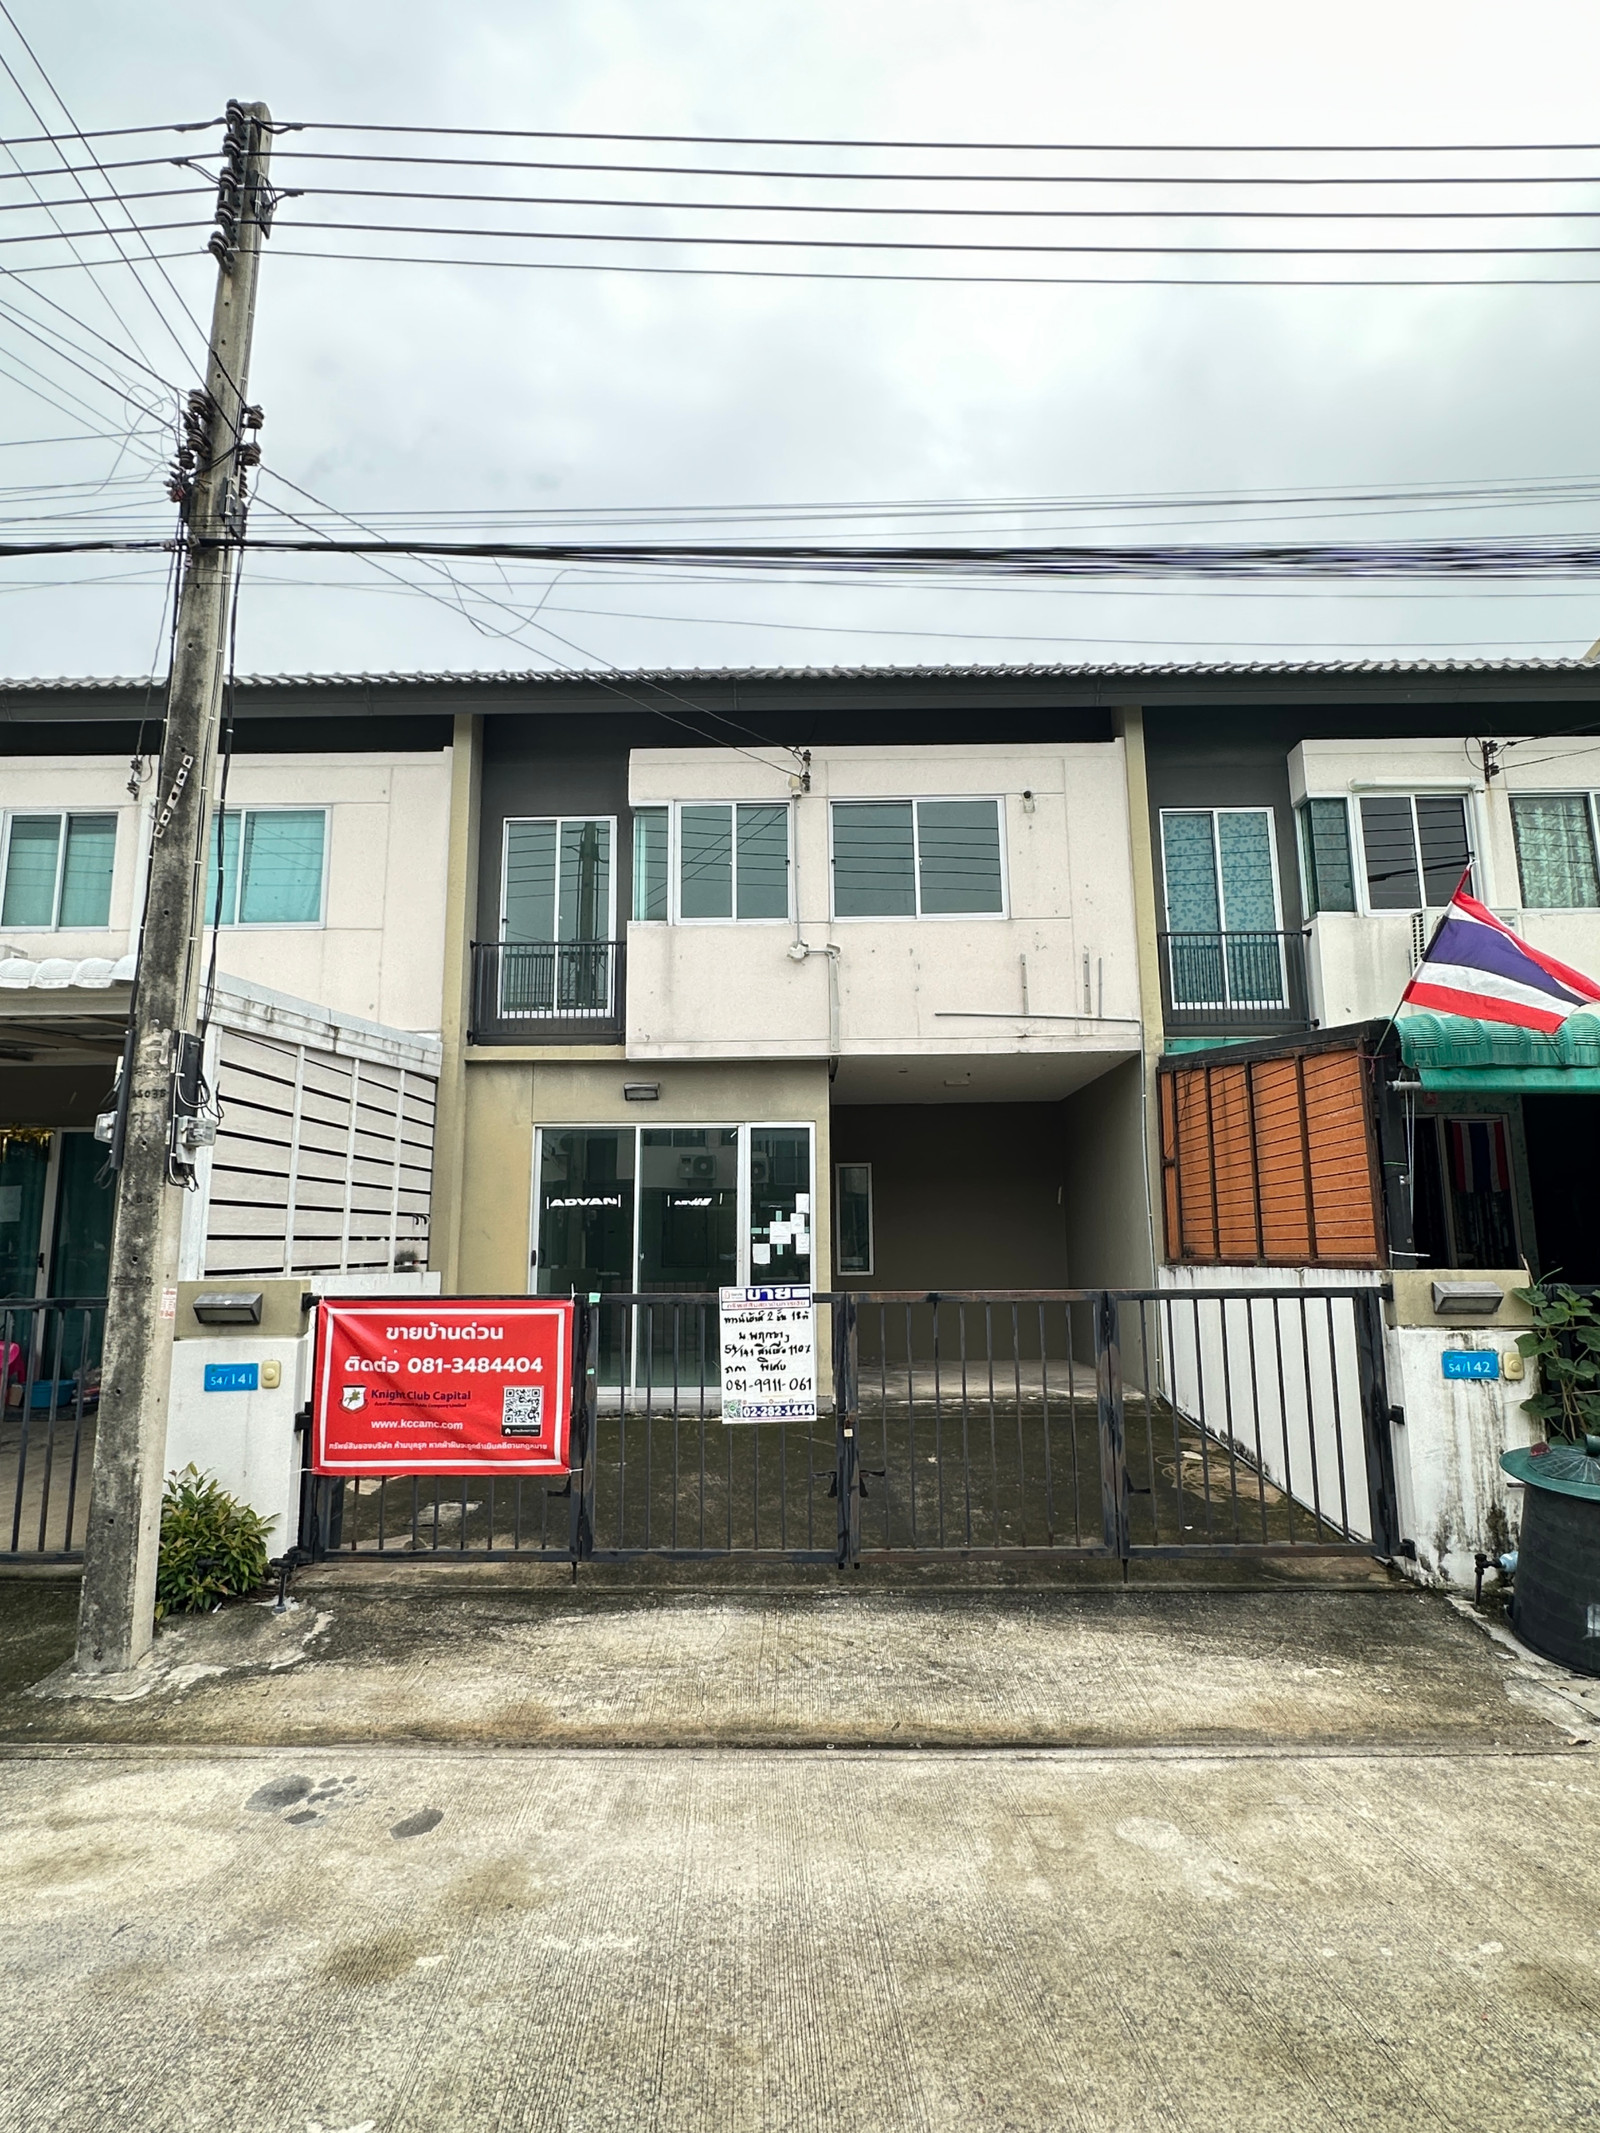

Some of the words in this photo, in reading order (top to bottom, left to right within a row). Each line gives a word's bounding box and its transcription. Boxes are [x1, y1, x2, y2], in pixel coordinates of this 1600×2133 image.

[550, 1197, 618, 1207] ADVAN
[747, 1287, 791, 1300] ขาย
[767, 1311, 773, 1321] 2
[386, 1322, 503, 1340] ขายบ้านด่วน
[345, 1355, 399, 1373] ติดต่อ
[407, 1357, 543, 1373] 081-3484404
[1449, 1361, 1491, 1373] 54/142
[211, 1373, 252, 1386] 54/141
[371, 1389, 406, 1401] Knight
[407, 1391, 430, 1400] Club
[433, 1390, 471, 1402] Capital
[743, 1405, 814, 1417] 02-282-1444
[371, 1419, 463, 1430] www.kccamc.com
